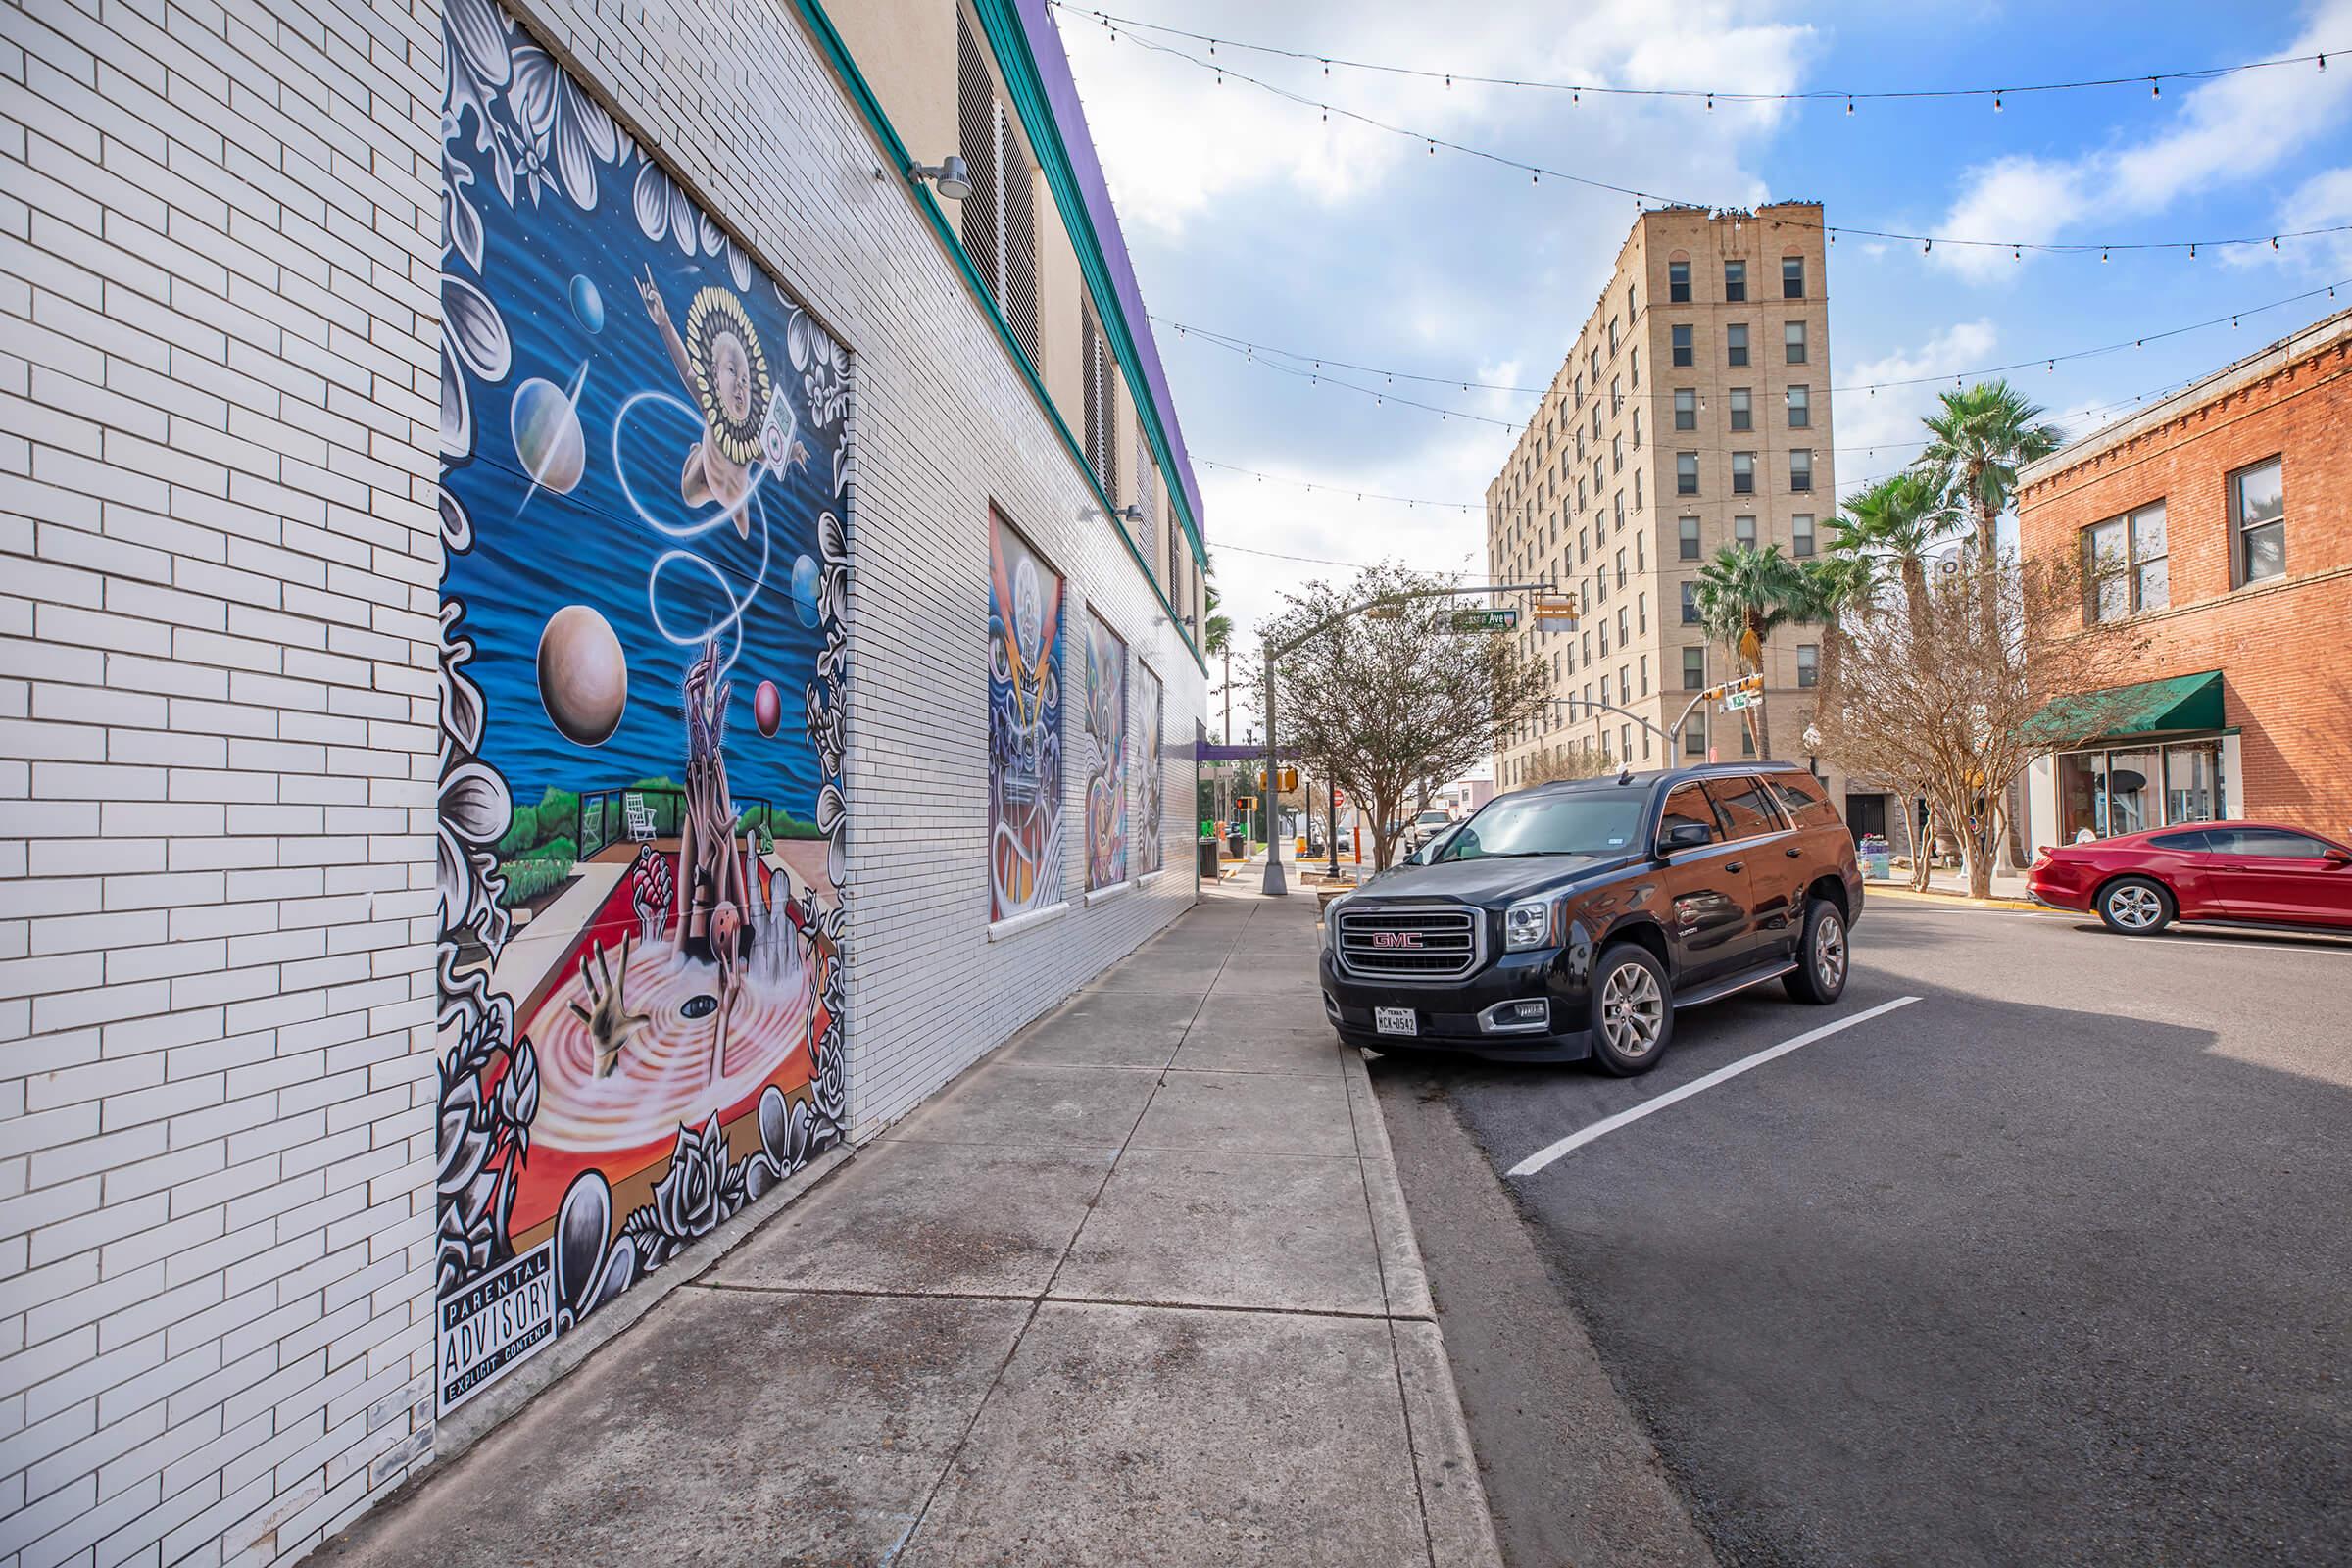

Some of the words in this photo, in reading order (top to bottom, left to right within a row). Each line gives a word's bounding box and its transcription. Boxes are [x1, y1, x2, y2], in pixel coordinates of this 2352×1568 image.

[1490, 612, 1504, 623] Ave
[1372, 932, 1423, 948] GMC
[448, 1254, 546, 1326] PARENTAL
[443, 1275, 552, 1380] ADVISORY
[448, 1356, 497, 1400] EXPLICIT
[504, 1323, 548, 1361] CONTENT
